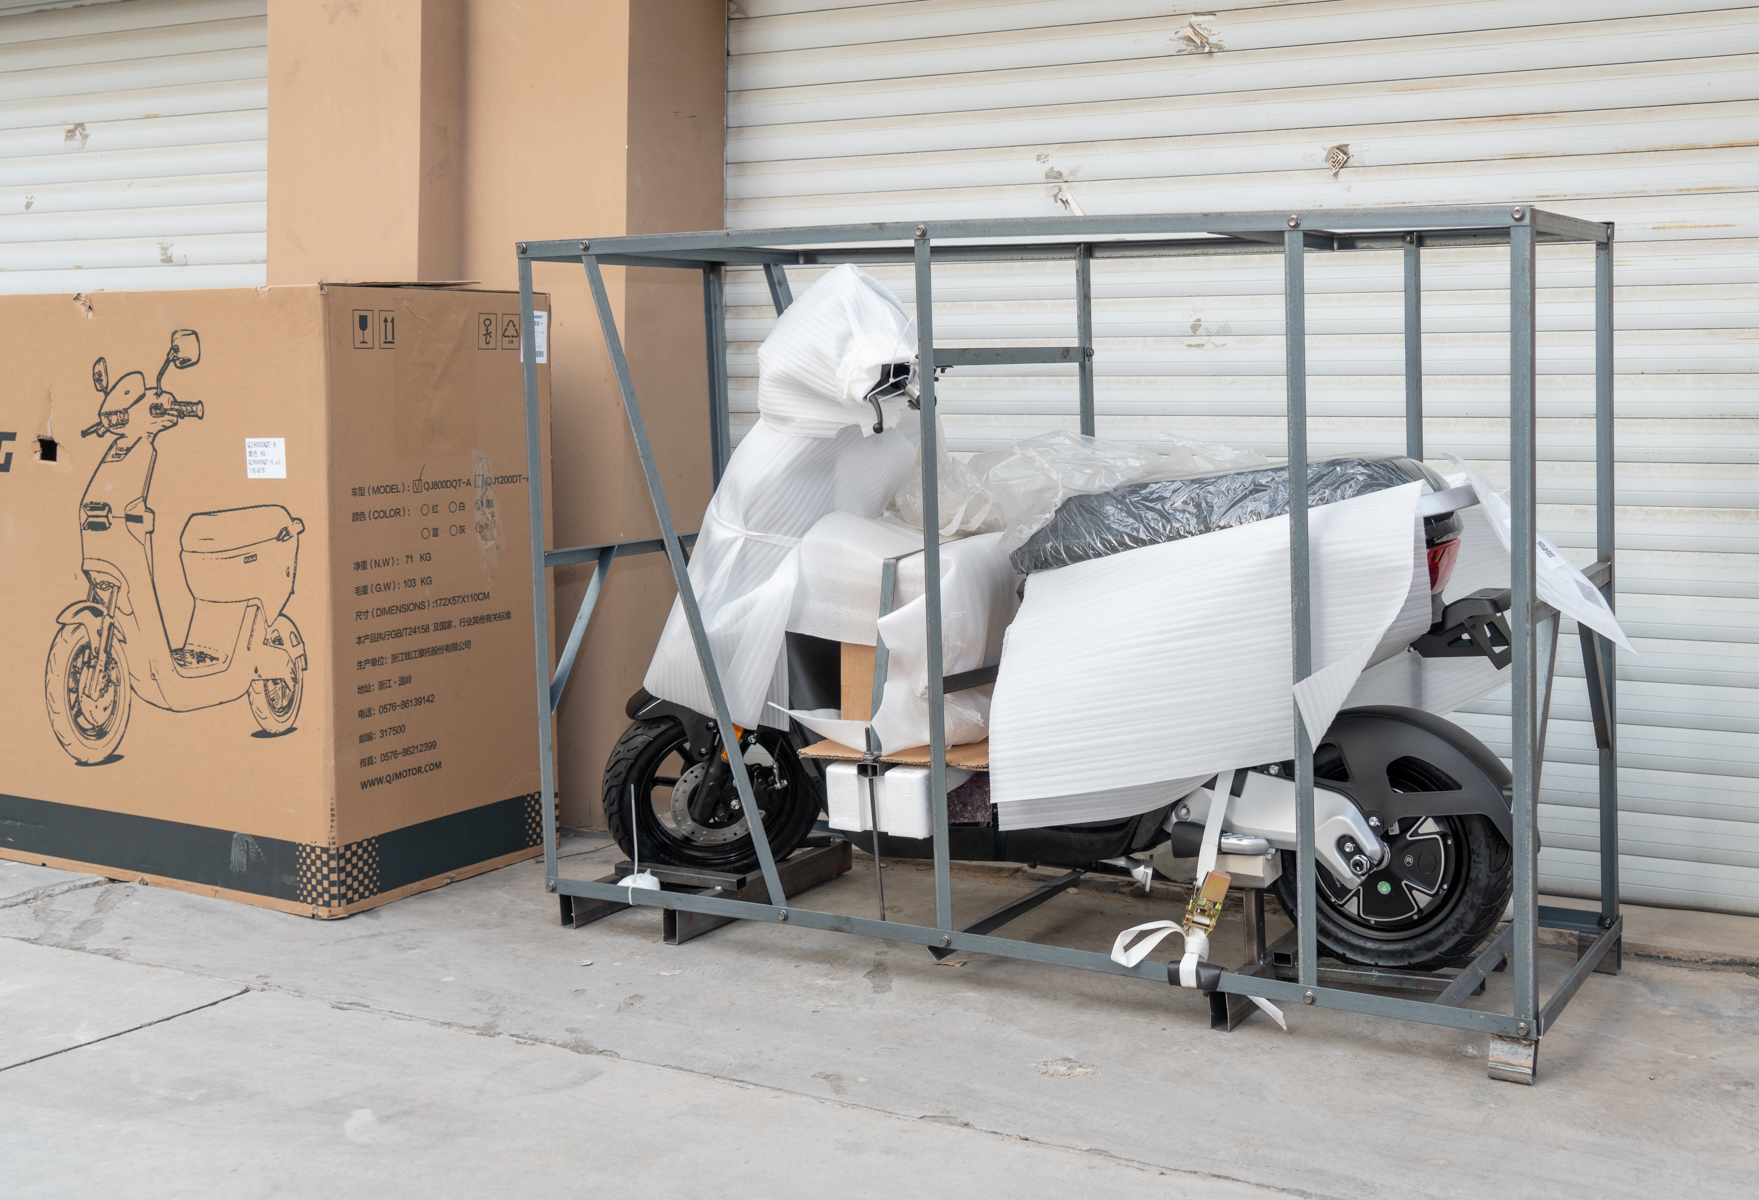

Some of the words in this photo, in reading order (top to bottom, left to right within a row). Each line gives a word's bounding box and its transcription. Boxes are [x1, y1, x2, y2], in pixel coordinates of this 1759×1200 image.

[423, 478, 471, 492] QJ800DQT-A
[485, 474, 528, 487] QJ1200DT-
[458, 502, 466, 511] 白
[458, 525, 466, 534] 灰
[404, 555, 414, 564] 71
[419, 552, 432, 563] KG
[403, 578, 417, 589] 103
[420, 576, 433, 586] KG
[360, 761, 442, 790] WWW.QJMOTOR.COM
